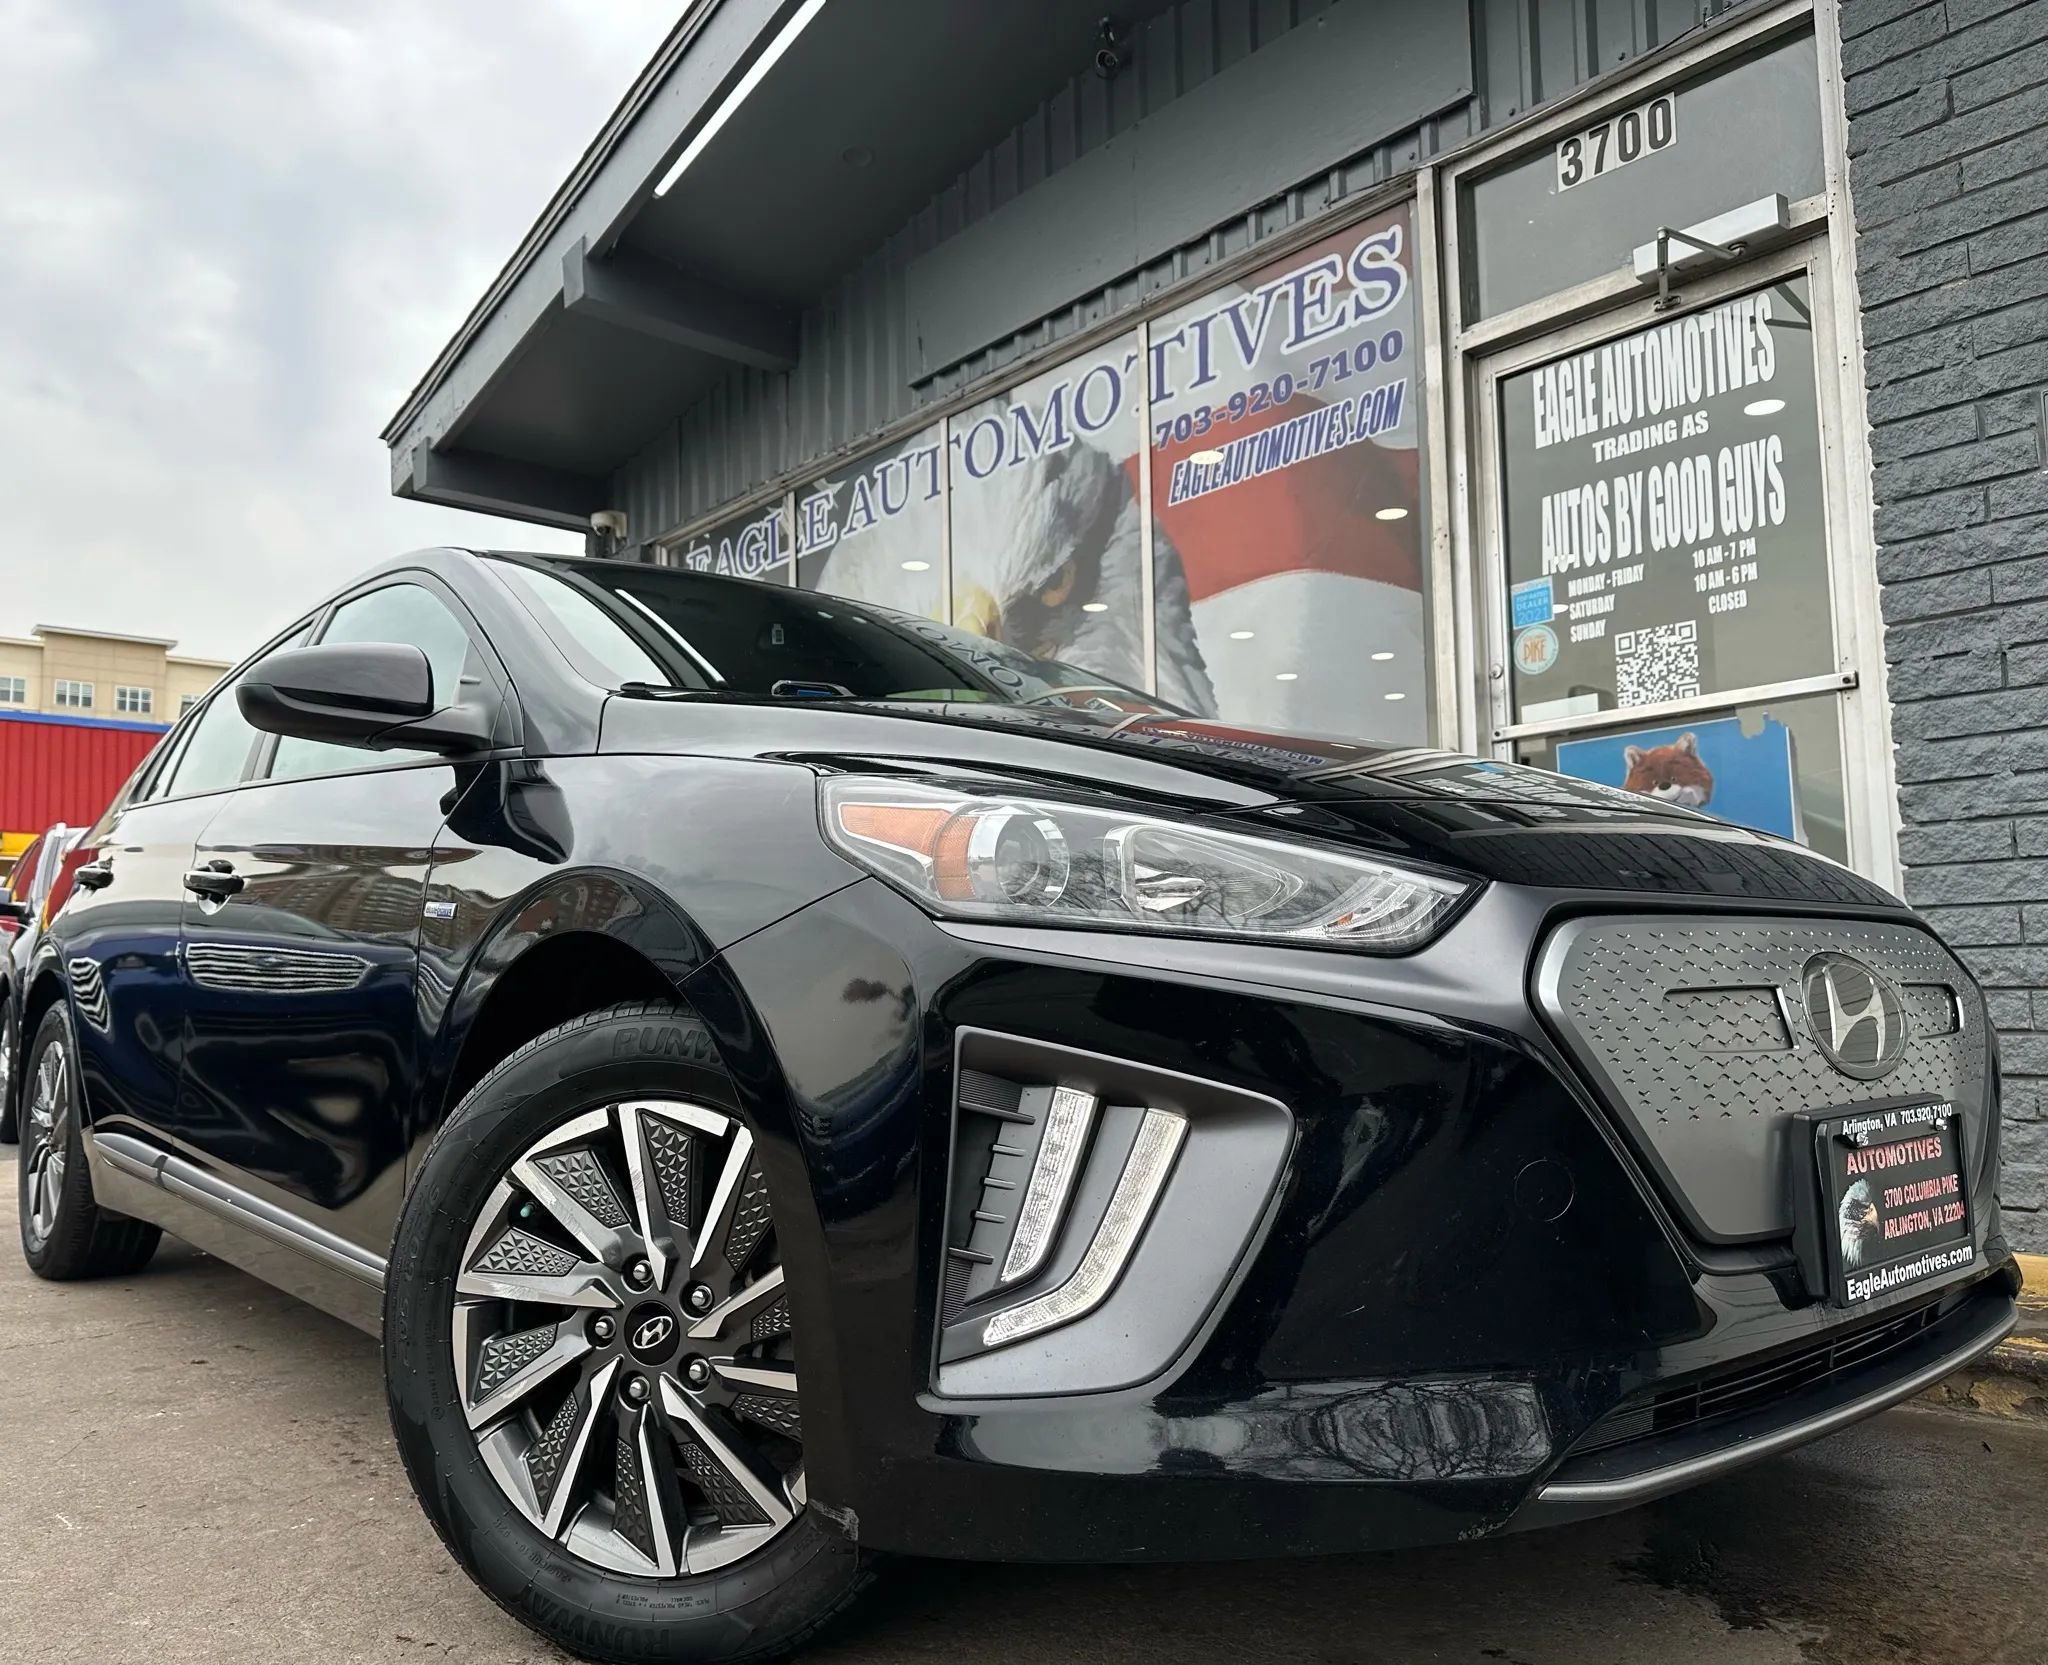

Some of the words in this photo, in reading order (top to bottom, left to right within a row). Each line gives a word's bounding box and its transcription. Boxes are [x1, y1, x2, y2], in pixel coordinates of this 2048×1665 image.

[1560, 97, 1673, 187] 3700
[1156, 330, 1403, 449] 703-920-7100
[1532, 350, 1598, 450] EAGLE
[1599, 293, 1777, 430] AUTOMOTIVES
[686, 489, 838, 577] EAGLE
[841, 225, 1408, 539] AUTOMOTIVES
[1169, 379, 1407, 507] EAGLEAUTOMOTIVES.COM
[1592, 418, 1677, 464] TRADING
[1681, 411, 1709, 438] AS
[1541, 481, 1611, 576] AUTOS
[1613, 471, 1644, 559] BY
[1648, 454, 1715, 552] GOOD
[1718, 435, 1786, 537] GUYS
[1692, 549, 1705, 569] 10
[1706, 545, 1723, 566] AM
[1729, 542, 1736, 560] 7
[1739, 537, 1756, 558] PM
[1568, 573, 1606, 597] MONDAY
[1611, 564, 1644, 587] FRIDAY
[1694, 573, 1707, 592] 10
[1708, 569, 1725, 590] AM
[1732, 566, 1739, 584] 6
[1740, 562, 1758, 583] PM
[1569, 594, 1616, 620] SATURDAY
[1708, 589, 1747, 614] CLOSED
[1570, 619, 1606, 643] SUNDAY
[612, 1027, 721, 1064] RUNW
[1842, 1117, 1883, 1136] Arlington,
[1884, 1112, 1897, 1128] VA
[1846, 1137, 1943, 1175] AUTOMOTIVES
[1884, 1188, 1903, 1208] 3700
[1904, 1178, 1940, 1204] COLUMBIA
[1940, 1174, 1959, 1194] PIKE
[1884, 1212, 1932, 1240] ARLINGTON,
[1932, 1207, 1944, 1227] VA
[1847, 1245, 1973, 1300] EagleAutomotives.com
